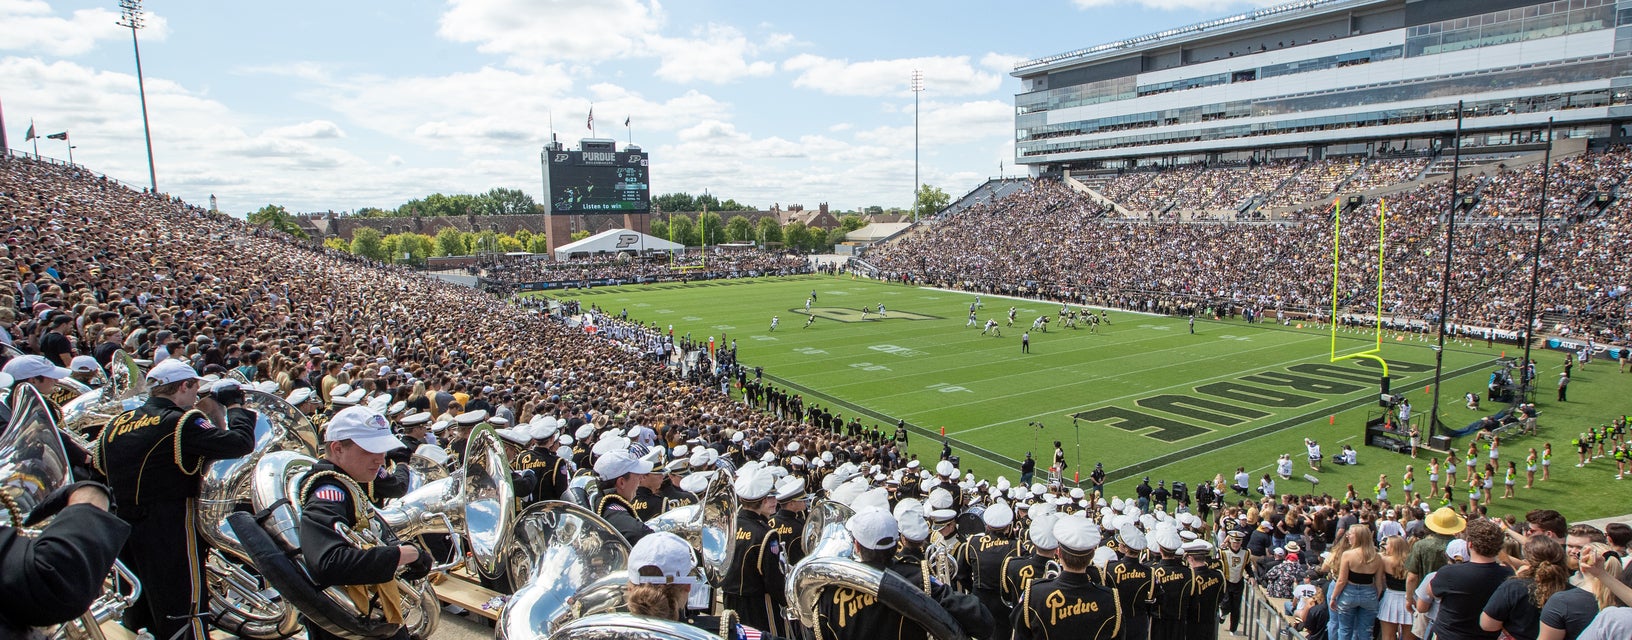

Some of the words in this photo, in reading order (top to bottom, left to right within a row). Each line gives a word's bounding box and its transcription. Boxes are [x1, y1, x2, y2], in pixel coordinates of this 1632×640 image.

[582, 152, 616, 162] PURDUE
[616, 234, 639, 248] P
[1560, 341, 1578, 350] AT&T
[1066, 357, 1437, 444] PURDUE
[108, 410, 160, 443] Purdue
[522, 454, 546, 470] Purdue
[980, 534, 1009, 552] Purdue
[1114, 563, 1146, 584] Purdue
[1155, 567, 1184, 584] Purdue
[1196, 575, 1219, 595] Purdue
[1046, 589, 1099, 626] Purdue
